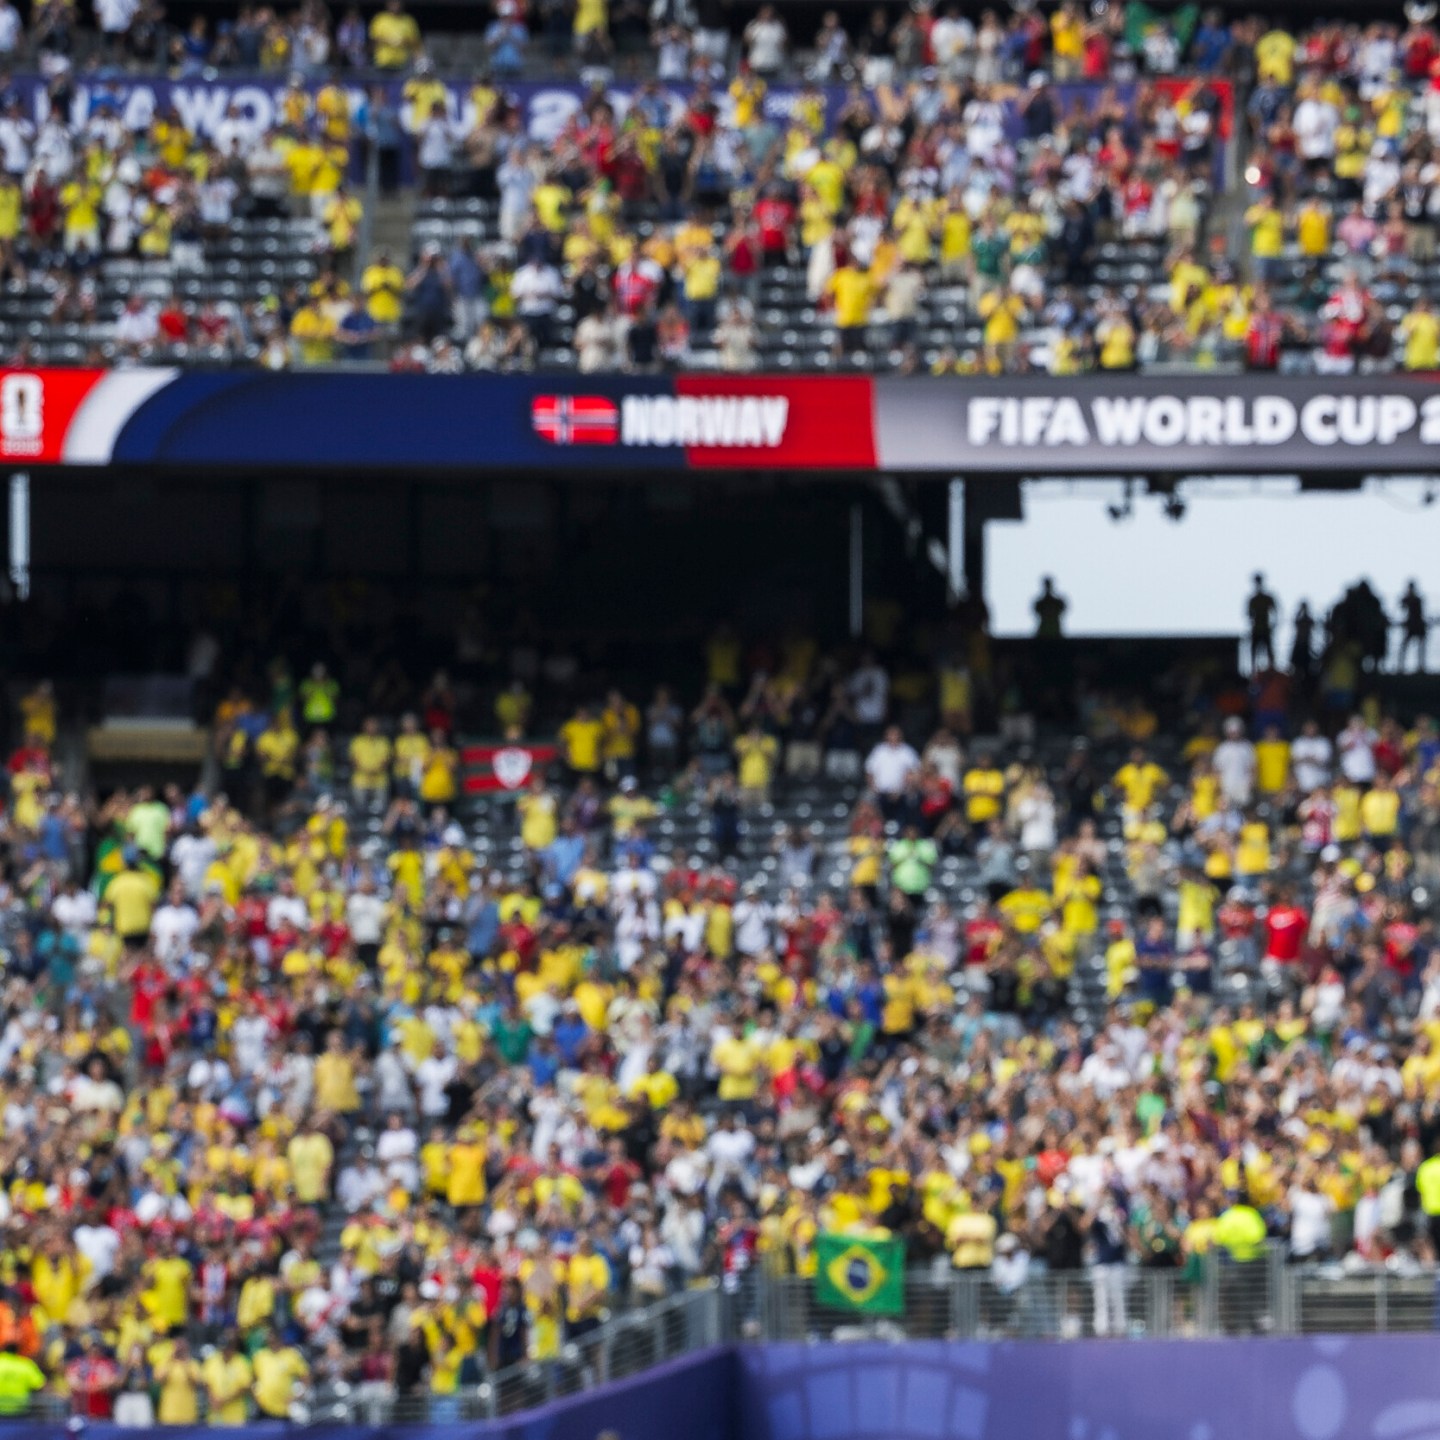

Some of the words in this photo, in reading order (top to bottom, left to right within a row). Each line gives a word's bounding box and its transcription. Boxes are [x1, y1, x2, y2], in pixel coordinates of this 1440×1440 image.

[622, 394, 789, 446] NORWAY
[967, 396, 1091, 446] FIFA
[1091, 395, 1297, 446] WORLD
[1301, 394, 1417, 446] CUP
